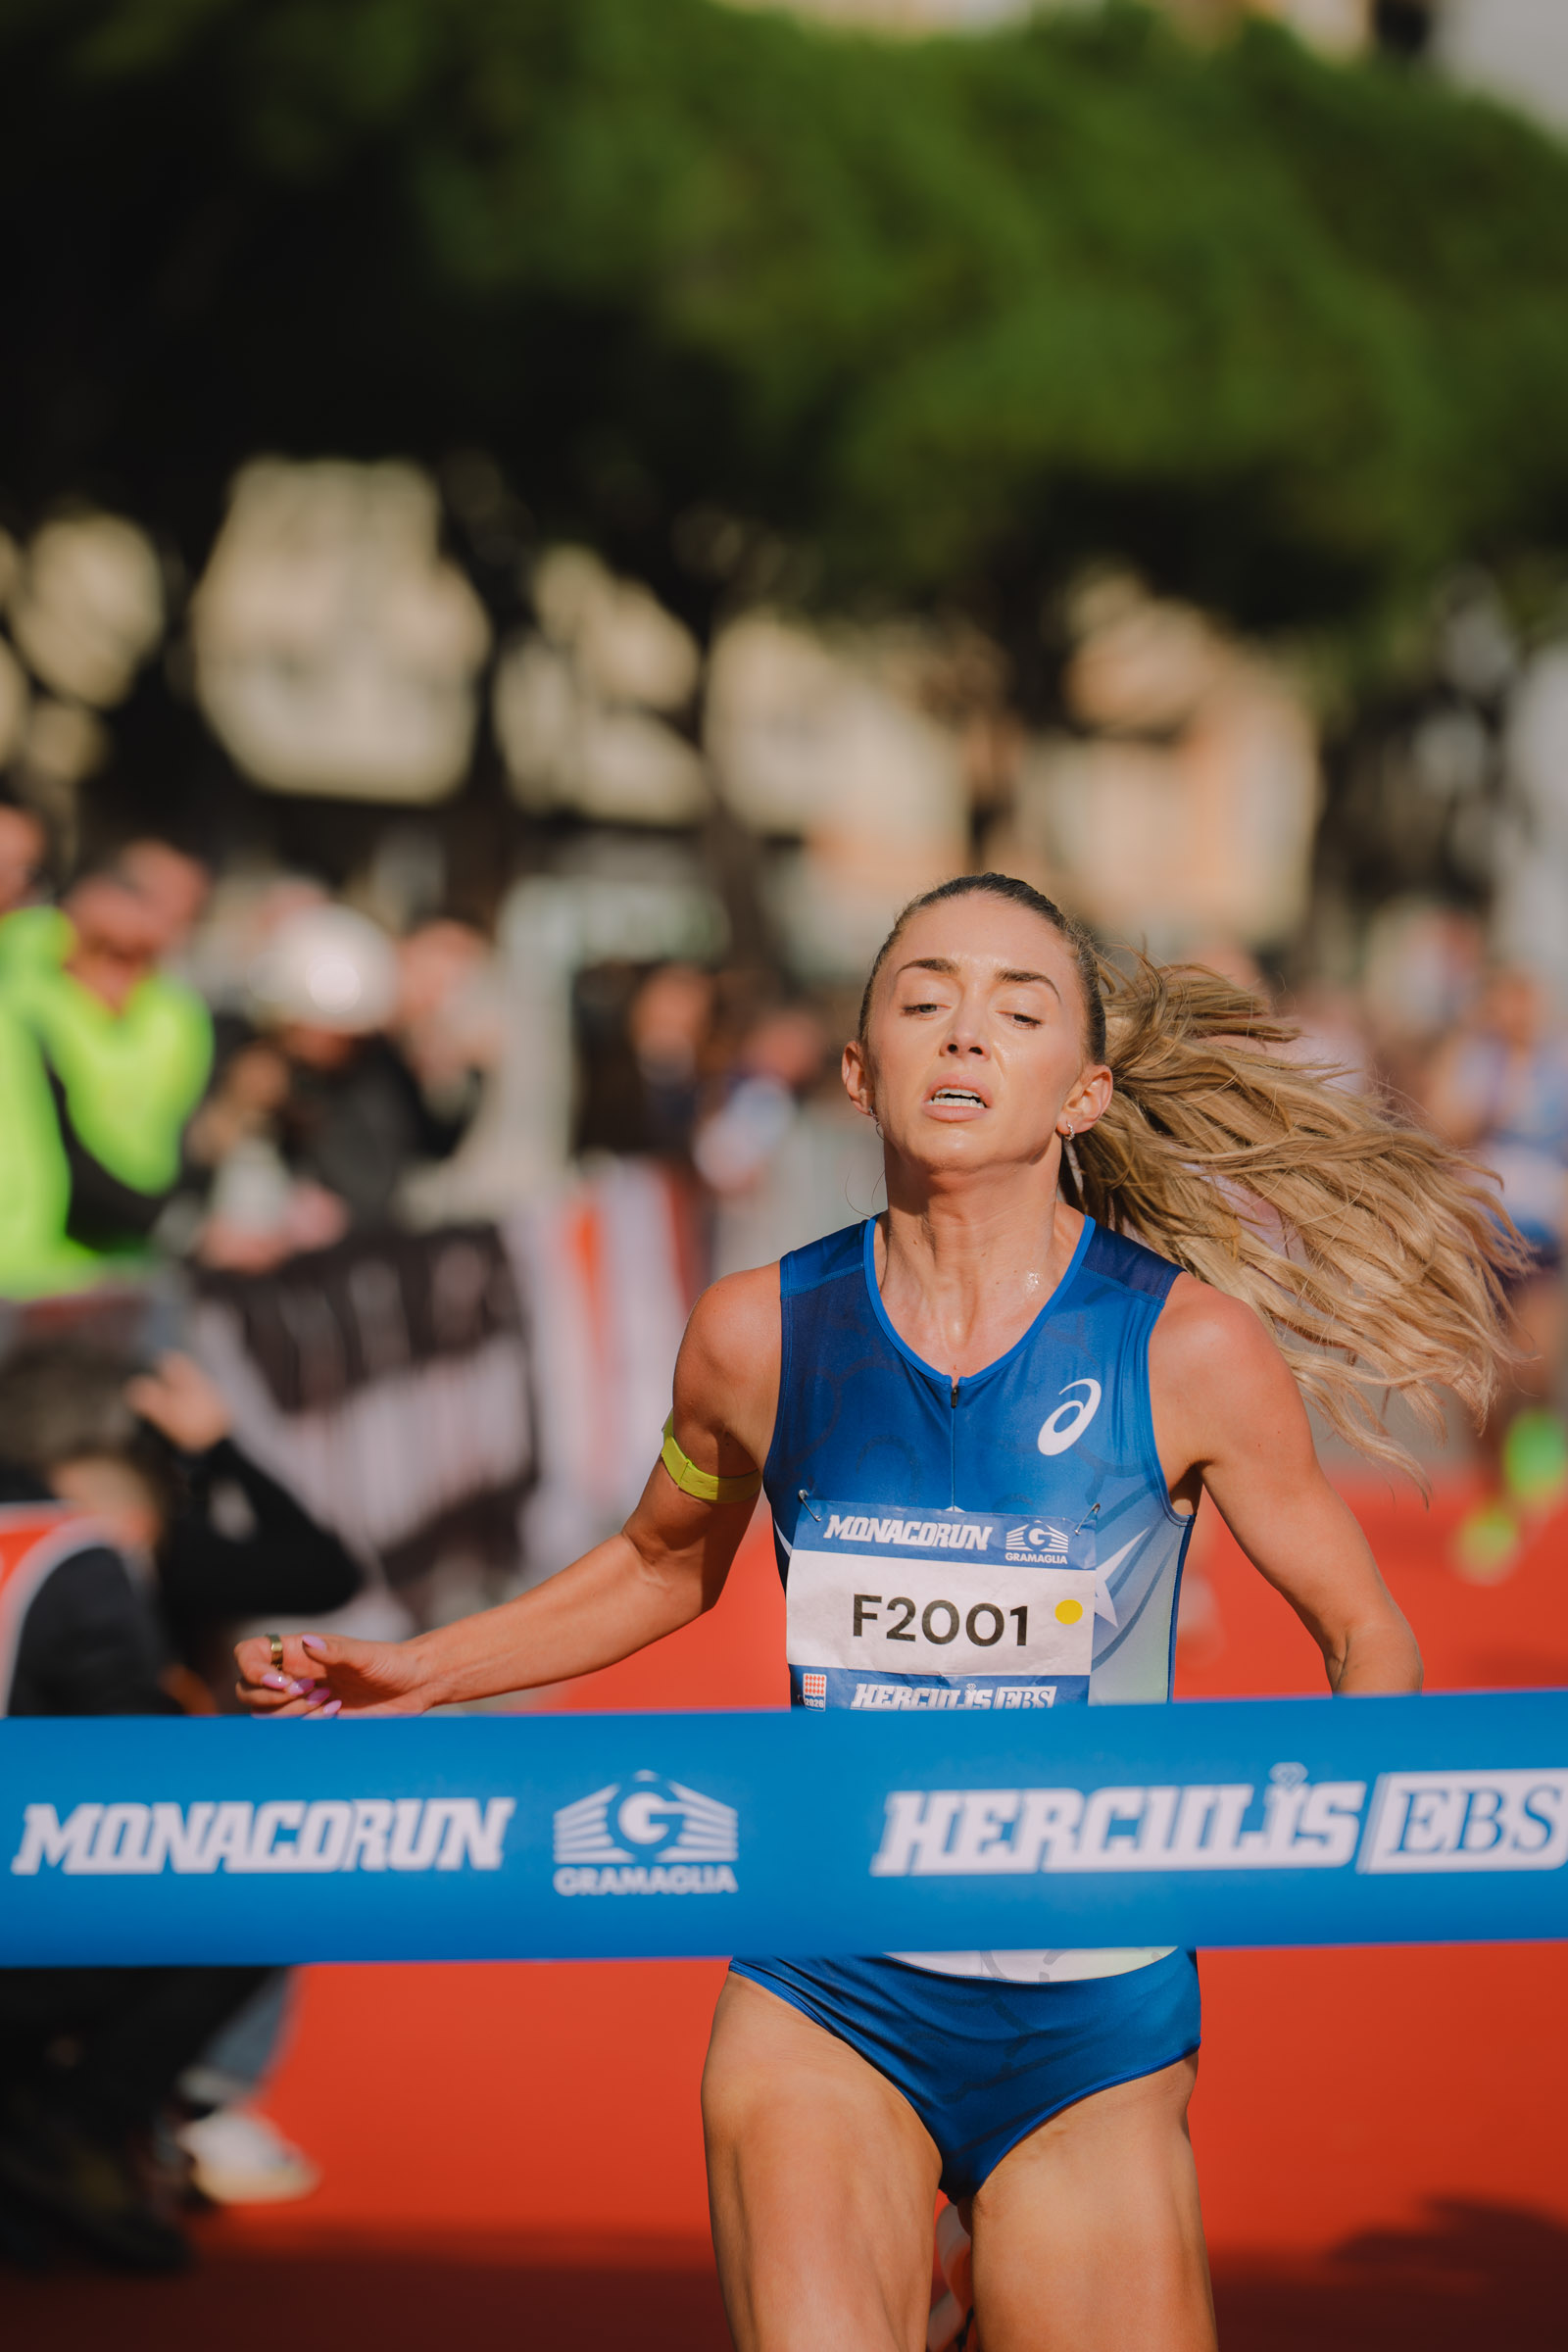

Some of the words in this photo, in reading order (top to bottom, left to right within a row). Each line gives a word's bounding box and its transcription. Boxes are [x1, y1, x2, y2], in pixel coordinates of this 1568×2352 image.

[823, 1515, 994, 1550] MONACORUN
[1004, 1551, 1068, 1565] GRAMAGLIA
[852, 1593, 1029, 1646] F2001
[1002, 1690, 1052, 1709] EBS
[13, 1796, 516, 1876] MONACORUN
[1388, 1784, 1564, 1855] EBS
[553, 1865, 739, 1897] GRAMAGLIA
